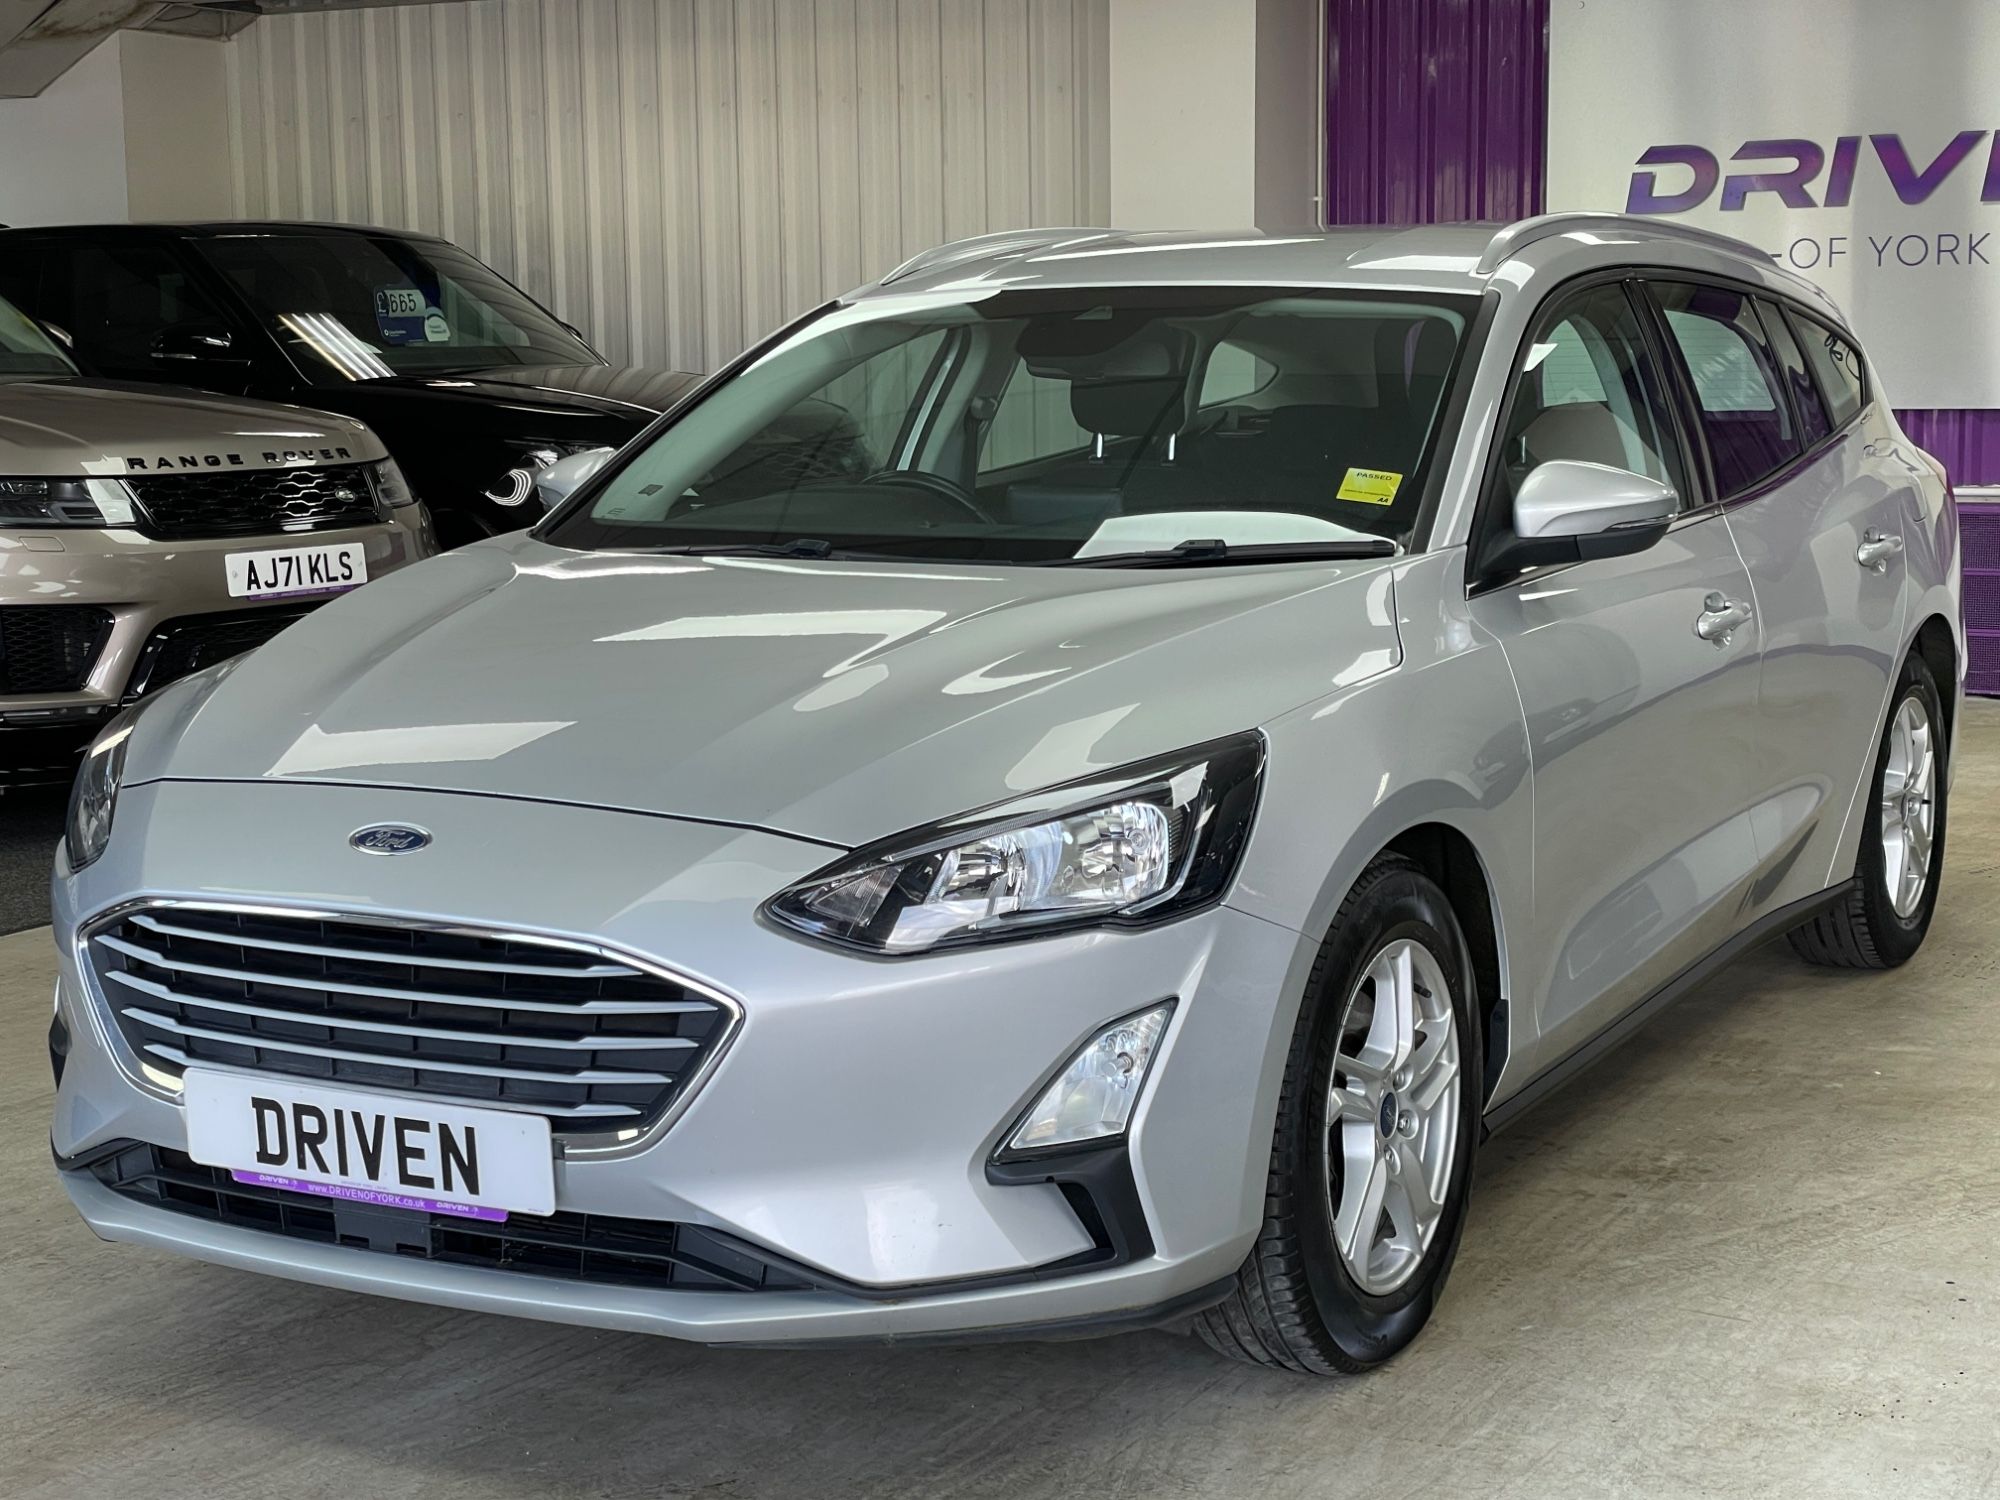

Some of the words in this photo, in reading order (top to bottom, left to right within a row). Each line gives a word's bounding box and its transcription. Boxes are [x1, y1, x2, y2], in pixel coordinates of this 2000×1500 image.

[1625, 129, 2000, 214] DRIV
[1868, 232, 1991, 267] YORK
[127, 453, 244, 470] RANGE
[262, 447, 351, 463] ROVER
[1356, 472, 1392, 481] PASSED
[246, 554, 302, 591] AJ71
[308, 551, 353, 584] KLS
[365, 829, 415, 848] Ford
[251, 1096, 480, 1196] DRIVEN
[258, 1174, 289, 1185] DRIVEN
[307, 1183, 426, 1209] www.DRIVENOFYORK.co.uk
[436, 1201, 469, 1212] DRIVEN
